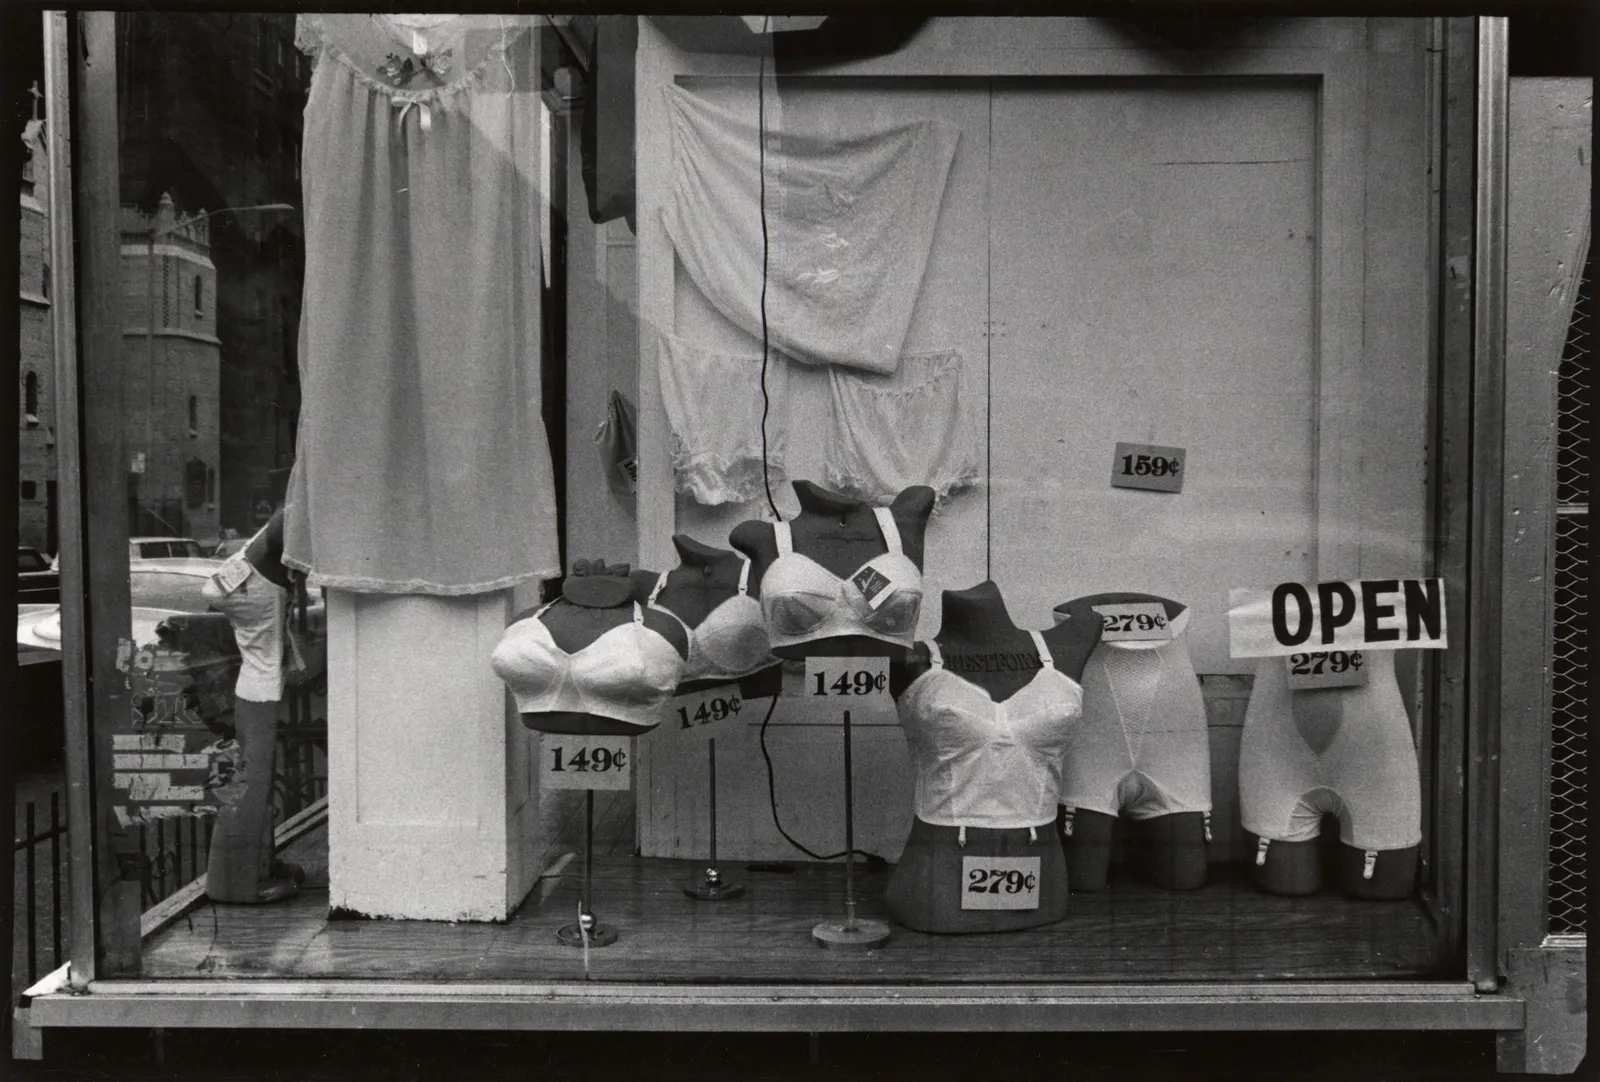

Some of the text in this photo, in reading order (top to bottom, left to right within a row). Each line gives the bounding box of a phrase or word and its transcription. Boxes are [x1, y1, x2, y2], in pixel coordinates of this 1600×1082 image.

[1121, 454, 1180, 477] 159¢
[1103, 613, 1166, 632] 279¢
[1272, 578, 1441, 646] OPEN
[1290, 650, 1364, 675] 279¢
[813, 670, 887, 696] 149¢
[676, 694, 742, 730] 149¢
[551, 746, 627, 772] 149¢
[968, 869, 1036, 894] 279¢
